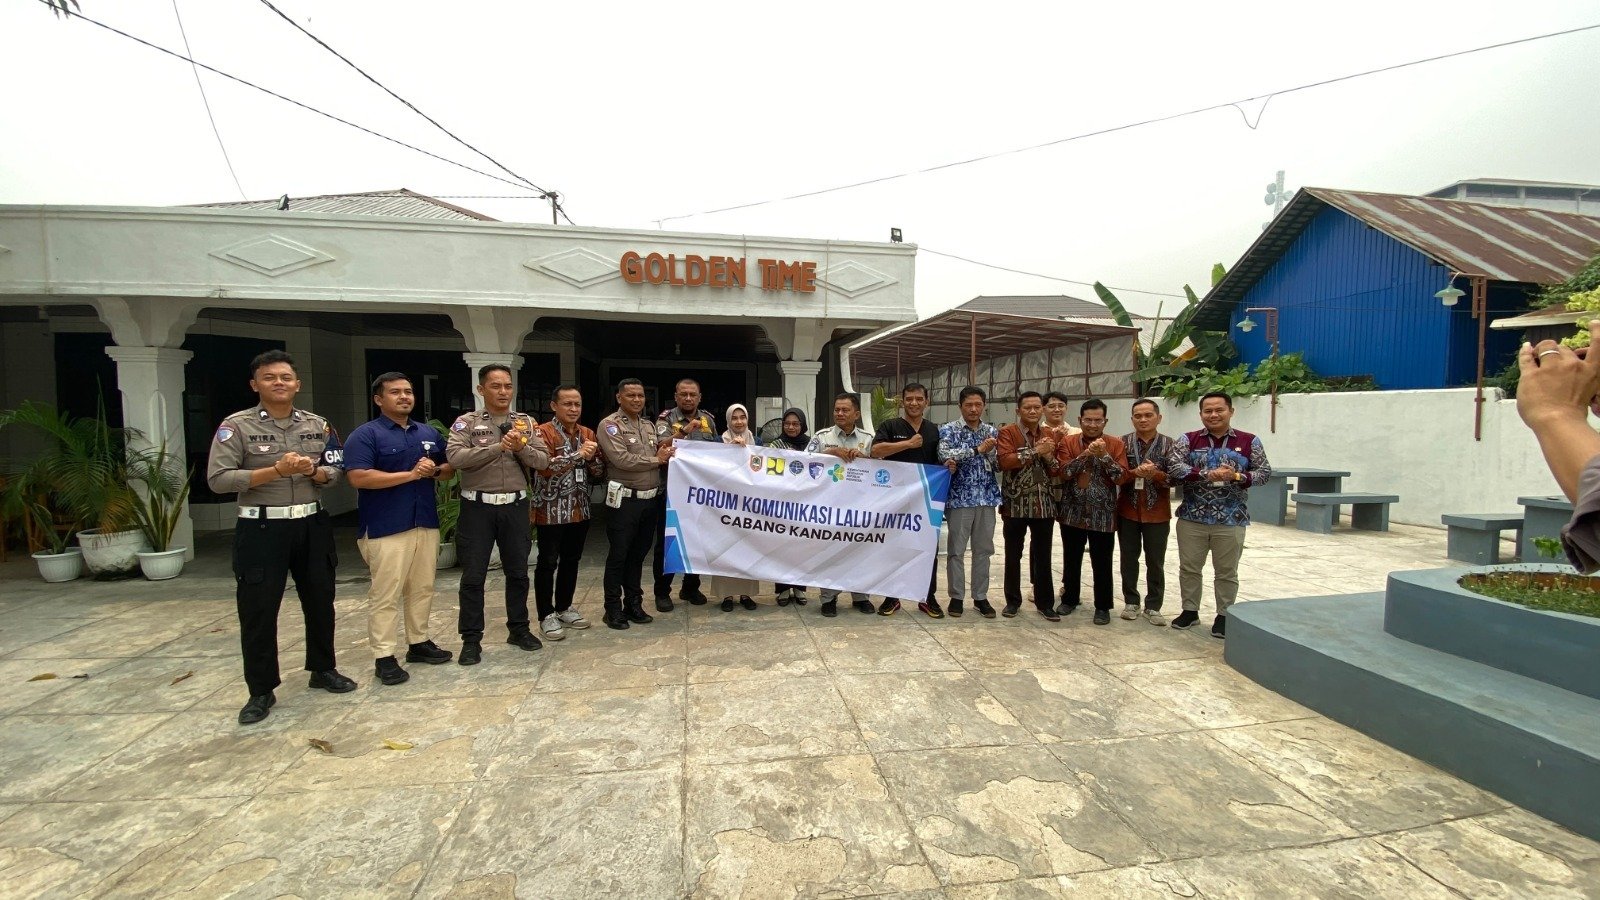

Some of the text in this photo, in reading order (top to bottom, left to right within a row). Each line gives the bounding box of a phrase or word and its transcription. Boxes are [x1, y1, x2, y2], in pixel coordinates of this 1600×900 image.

[620, 250, 817, 293] GOLDEN TIME
[249, 432, 323, 442] WIRA POLRI
[687, 486, 922, 532] FORUM KOMUNIKASI LALU LINTAS
[720, 514, 886, 544] CABANG KANDANGAN
